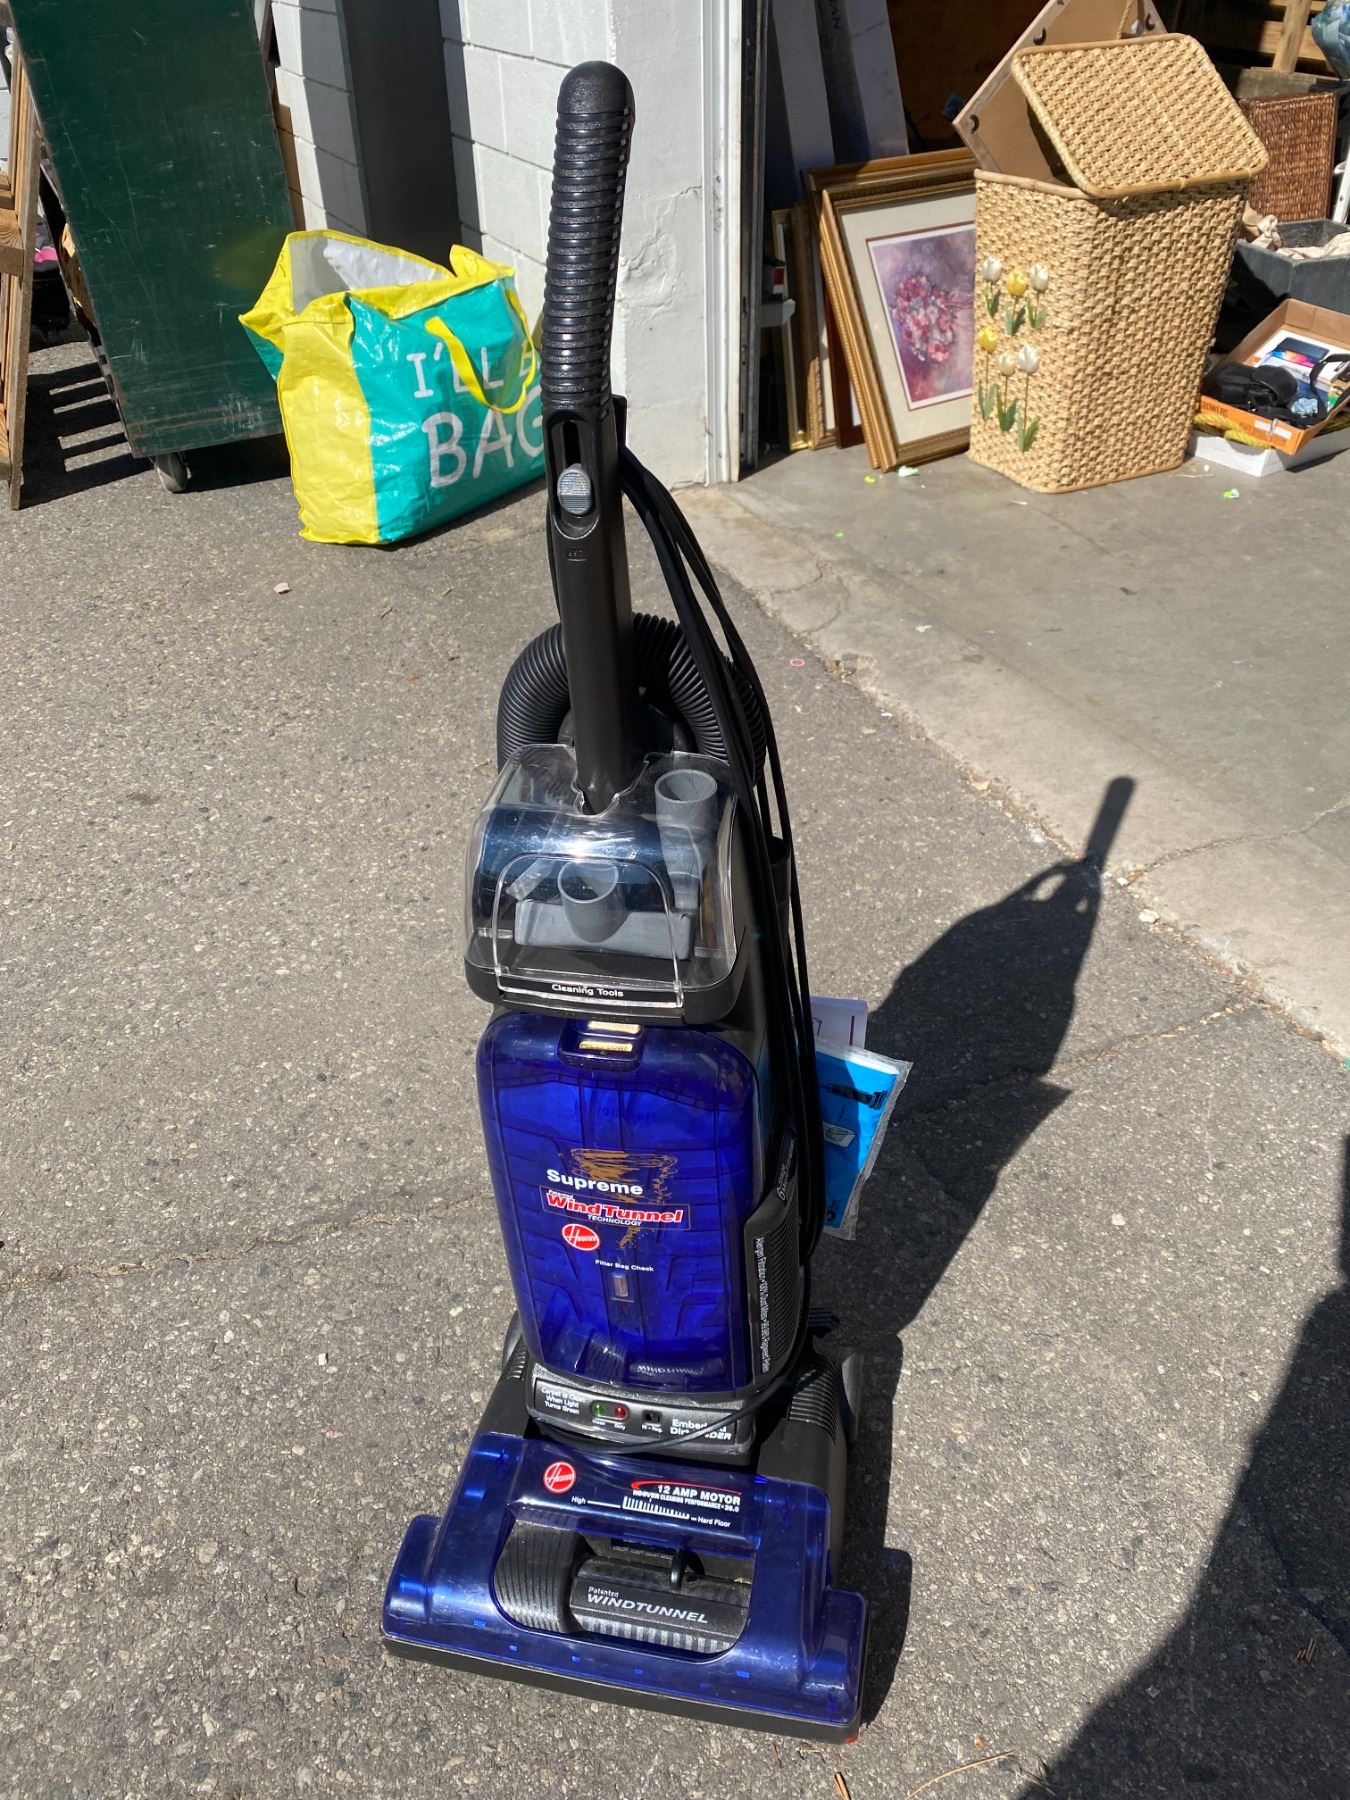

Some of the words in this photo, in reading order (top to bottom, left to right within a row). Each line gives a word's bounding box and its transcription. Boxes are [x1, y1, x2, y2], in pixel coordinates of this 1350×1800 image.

[406, 342, 504, 398] I'LL
[551, 983, 594, 996] Cleaning
[596, 988, 624, 998] Tools
[546, 1168, 643, 1195] Supreme
[587, 1214, 642, 1227] TECHNOLOGY
[615, 1262, 629, 1271] Bag
[631, 1264, 654, 1273] Check
[571, 1496, 586, 1505] High
[632, 1489, 660, 1500] HOOVER
[657, 1484, 671, 1494] 12
[672, 1486, 698, 1498] AMP
[699, 1490, 741, 1506] MOTOR
[697, 1516, 713, 1526] Hard
[713, 1519, 731, 1528] Floor
[588, 1586, 619, 1598] Patented
[587, 1593, 709, 1624] WINDTUNNEL
